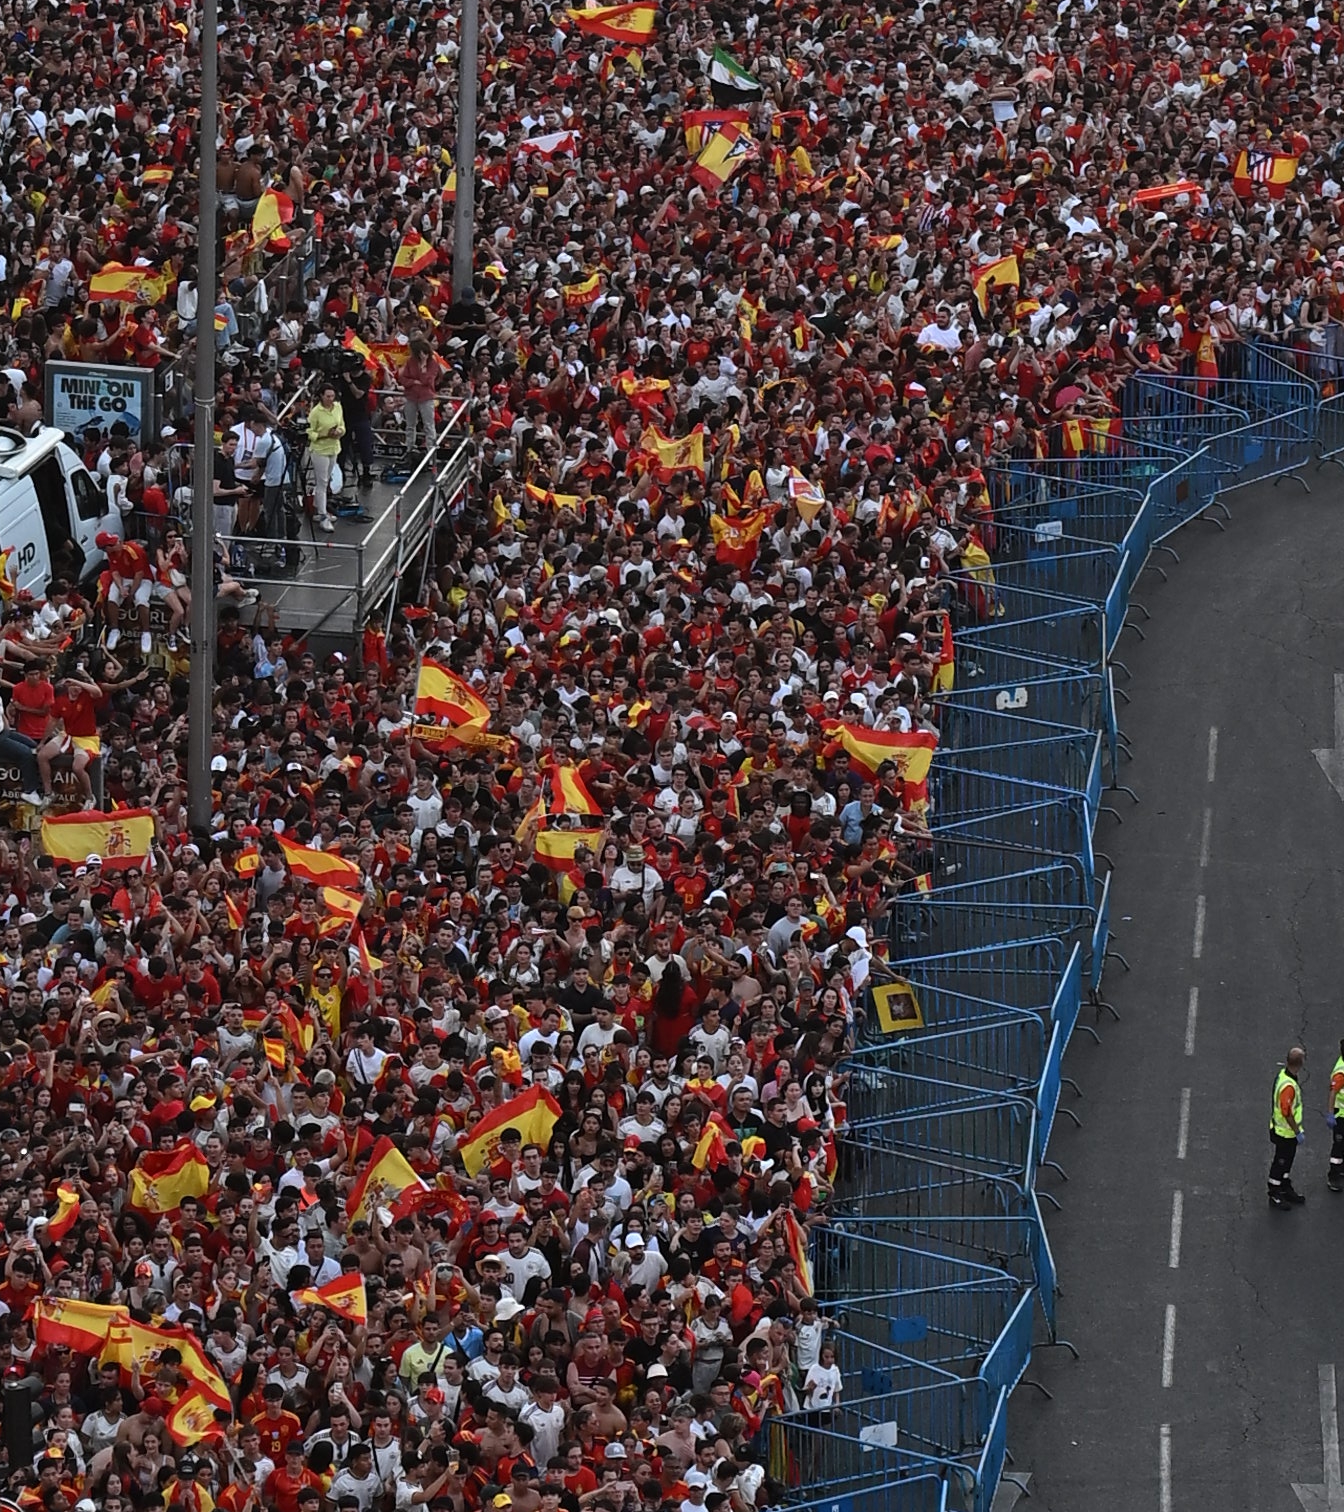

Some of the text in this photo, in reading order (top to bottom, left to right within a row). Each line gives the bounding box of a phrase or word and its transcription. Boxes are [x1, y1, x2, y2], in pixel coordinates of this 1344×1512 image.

[61, 378, 135, 398] MINI ON
[68, 394, 127, 413] THE GO
[17, 542, 36, 570] HD
